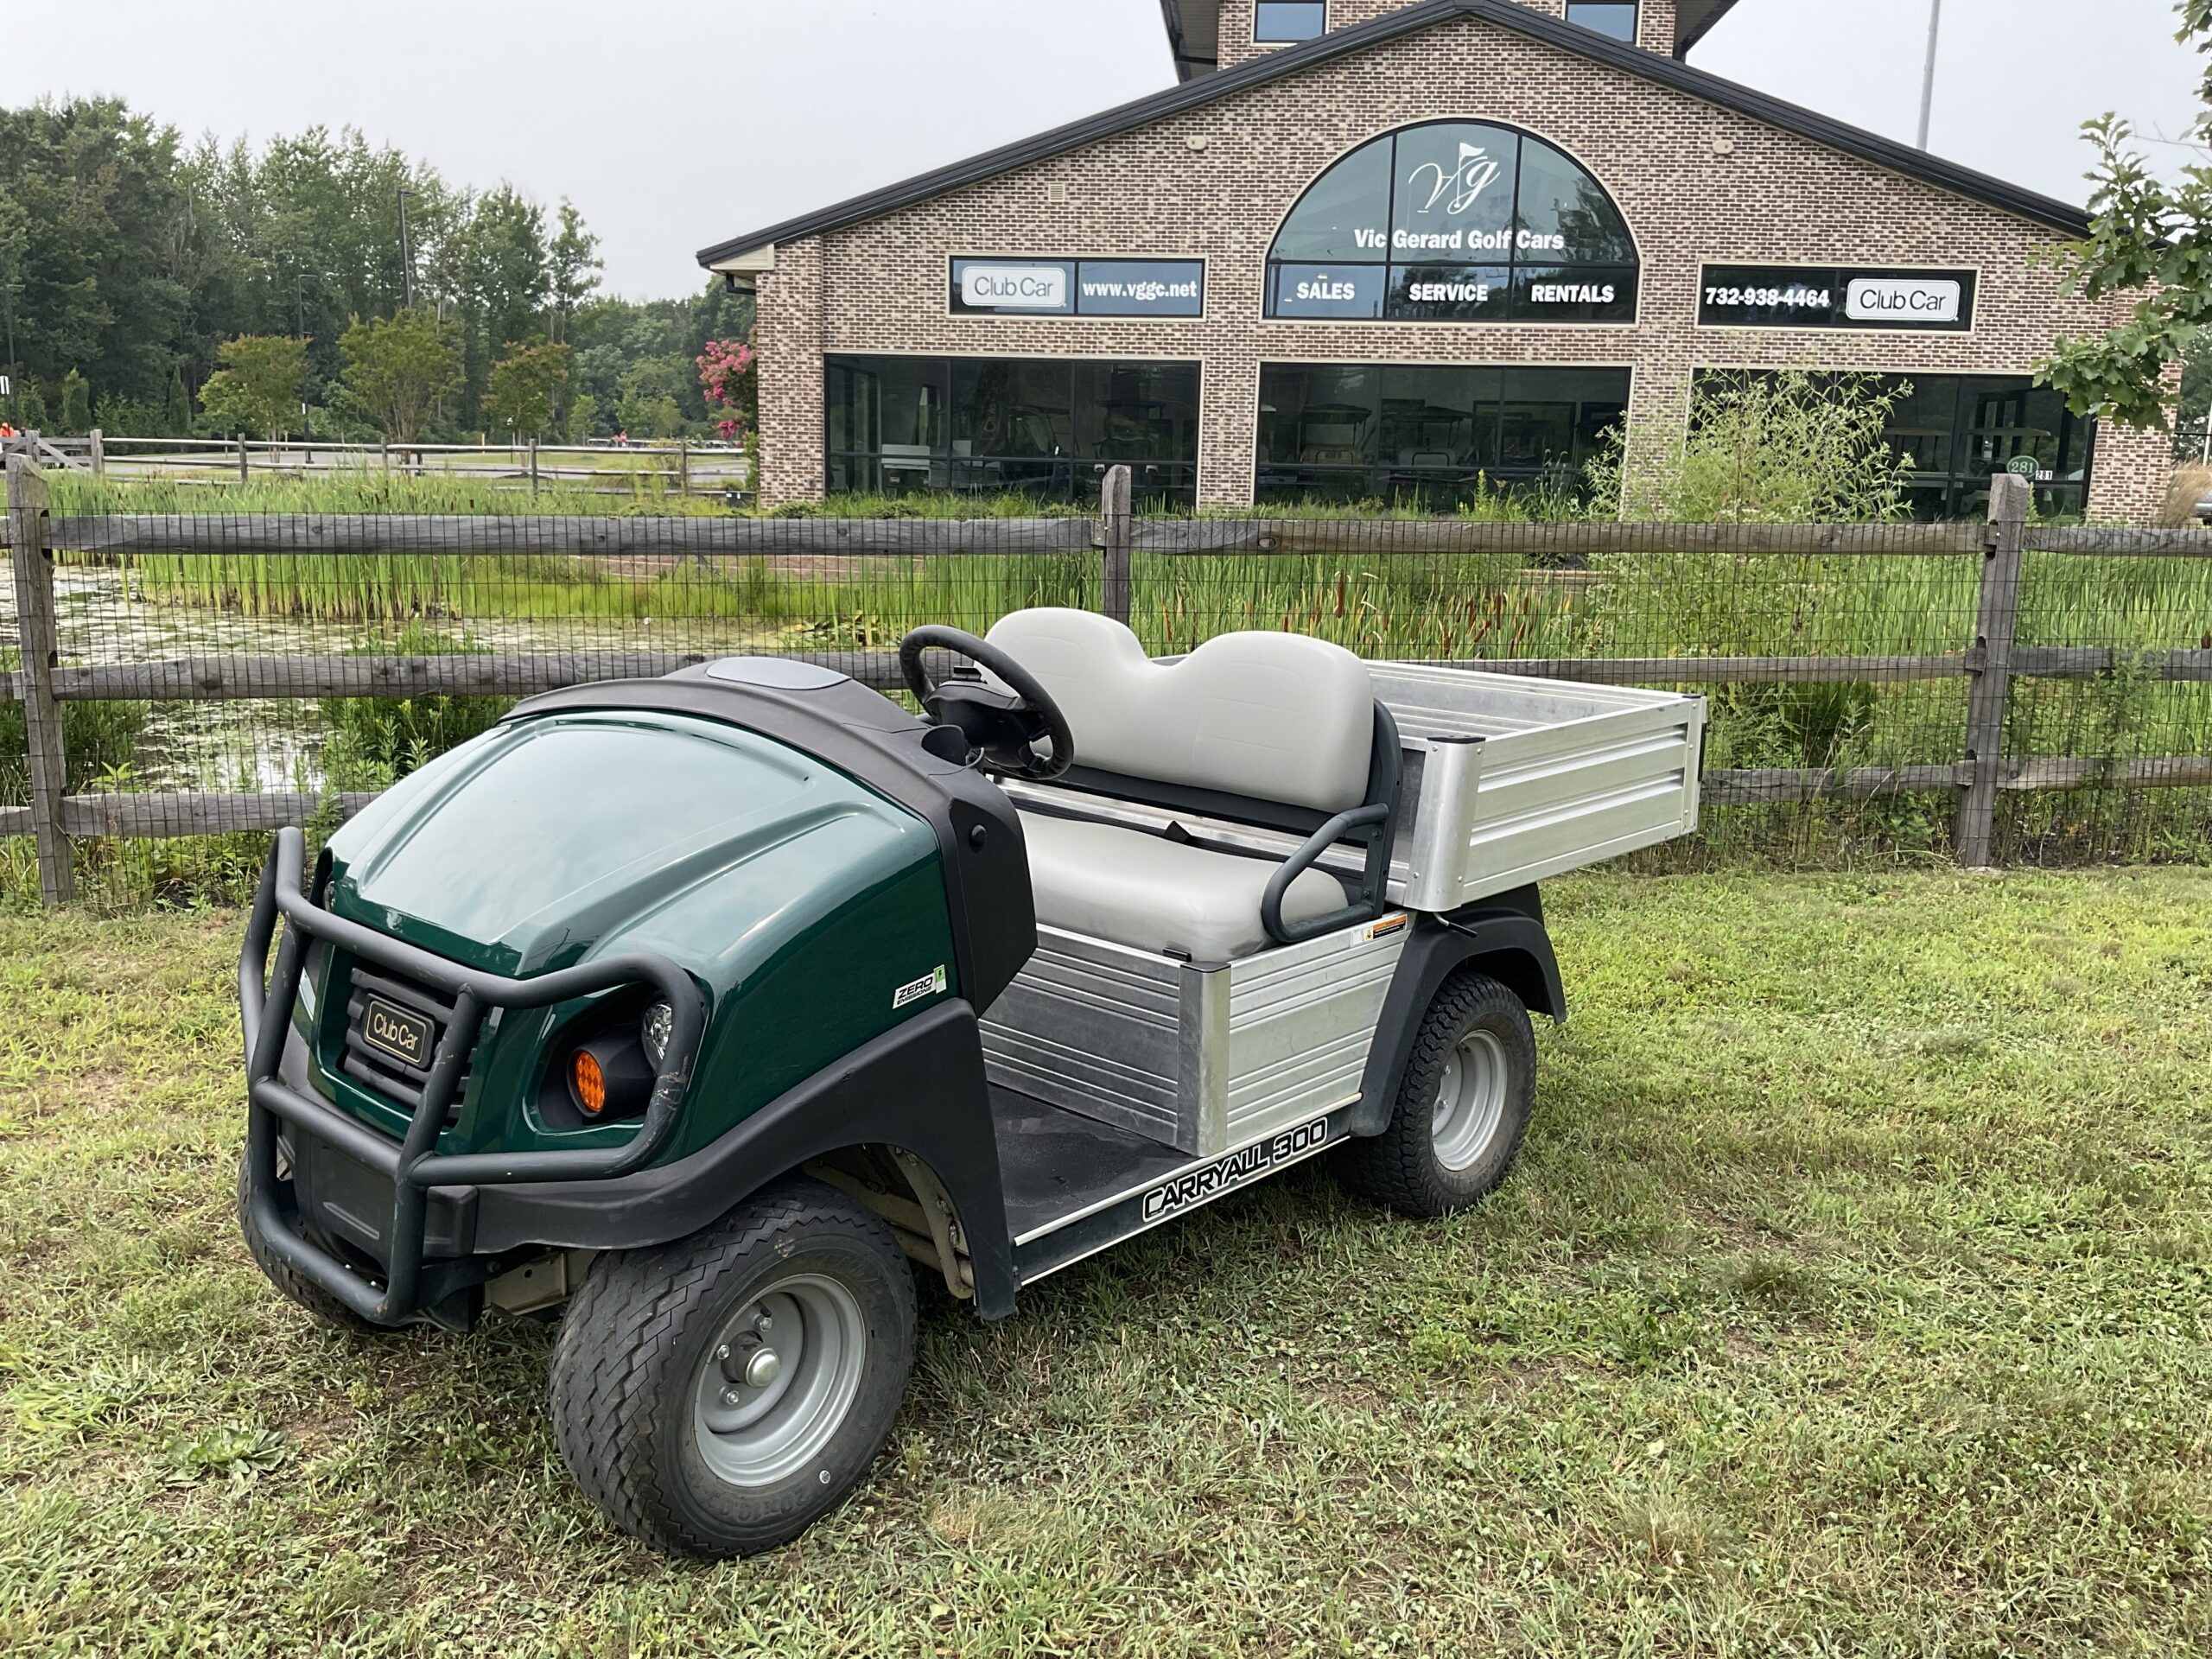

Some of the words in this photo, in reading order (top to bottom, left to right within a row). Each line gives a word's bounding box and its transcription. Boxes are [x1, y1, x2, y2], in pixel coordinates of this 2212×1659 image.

[1354, 229, 1386, 249] Vic
[1392, 229, 1462, 249] Gerard
[1468, 229, 1512, 250] Golf
[1516, 231, 1565, 251] Cars
[974, 276, 1017, 296] Club
[1020, 277, 1053, 297] Car
[1083, 281, 1197, 301] www.vggc.net
[1296, 283, 1355, 300] SALES
[1408, 283, 1489, 302] SERVICE
[1531, 284, 1615, 303] RENTALS
[1705, 287, 1829, 308] 732-938-4464
[1859, 289, 1906, 310] Club
[1909, 290, 1947, 311] Car
[2011, 461, 2034, 473] 281
[2037, 471, 2051, 480] 281
[898, 976, 933, 1000] ZERO
[373, 1013, 398, 1042] Club
[398, 1025, 419, 1051] Car
[1143, 1145, 1270, 1222] CARRYALL
[1273, 1116, 1328, 1164] 300
